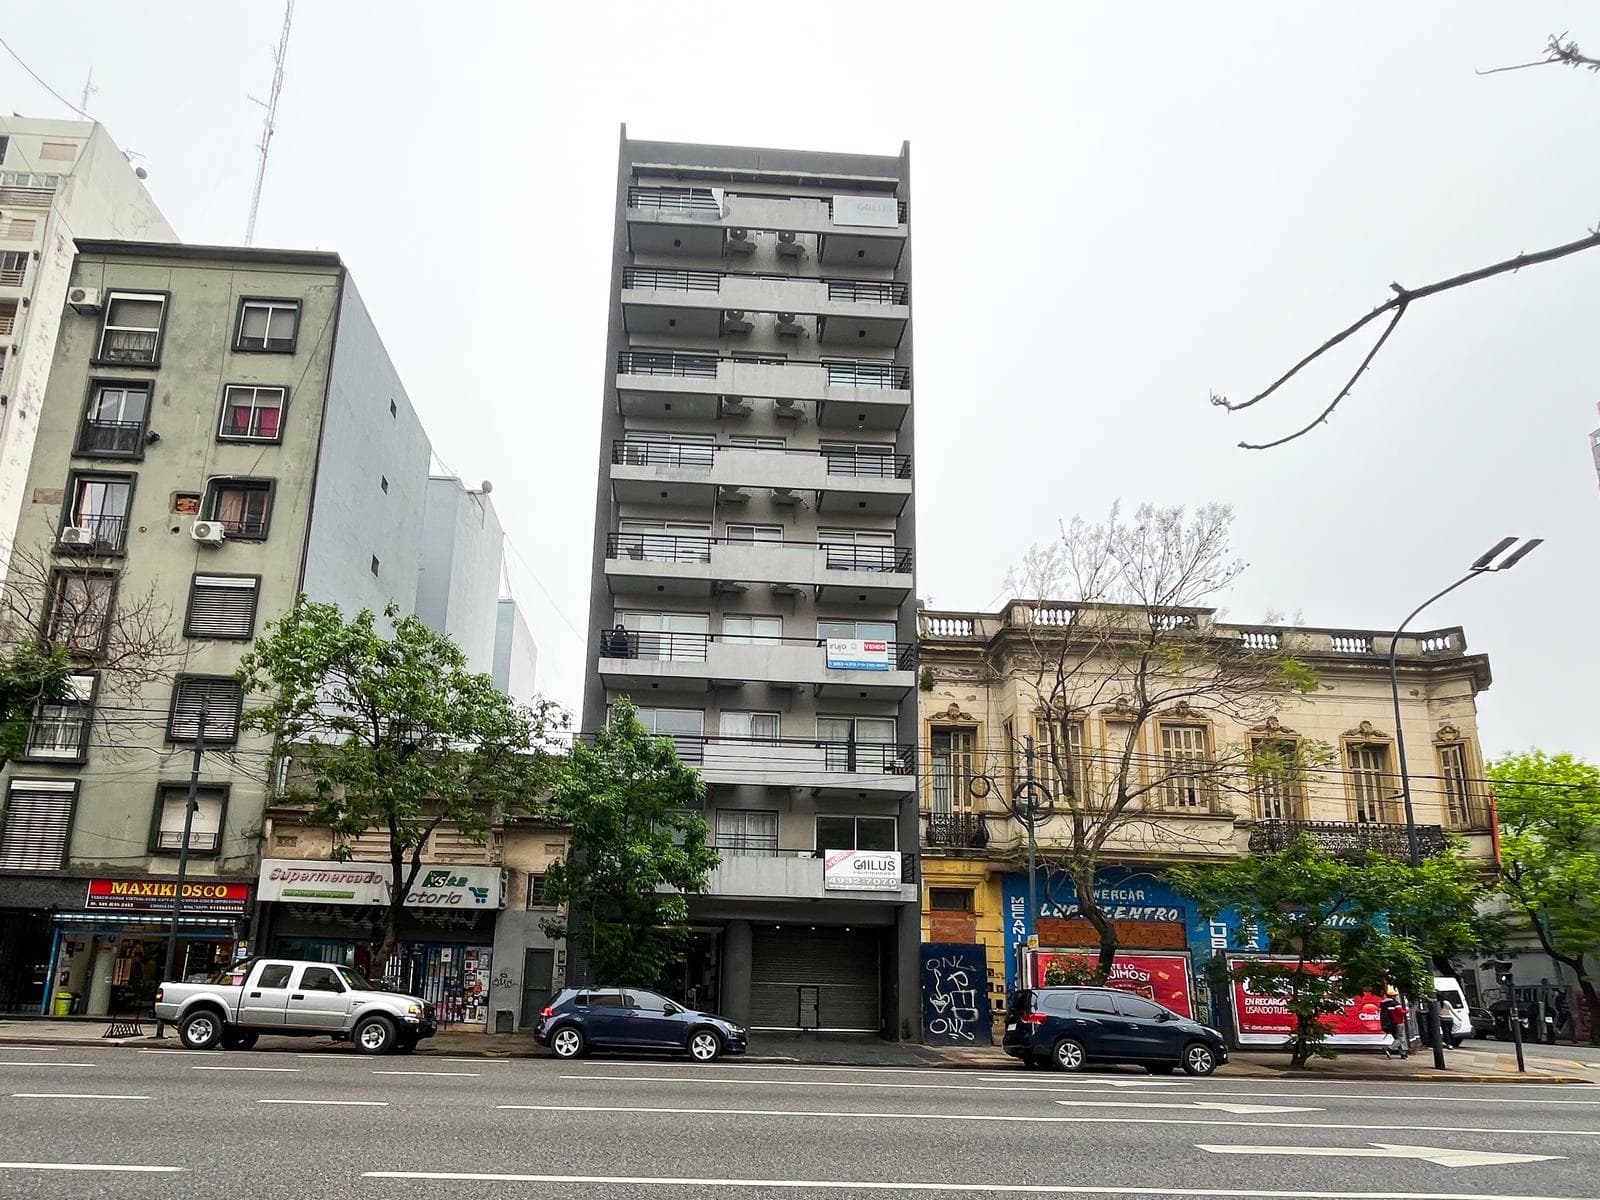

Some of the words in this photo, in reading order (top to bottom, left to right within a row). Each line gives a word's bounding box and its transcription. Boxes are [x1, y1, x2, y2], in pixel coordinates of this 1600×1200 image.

[853, 859, 896, 871] GAILUS
[269, 868, 384, 884] Supermercado
[1072, 888, 1145, 901] TWERCAR
[1107, 970, 1150, 981] JIMOS!
[1244, 998, 1255, 1006] EN
[1255, 998, 1291, 1006] RECARGA
[1245, 1006, 1274, 1014] USANDO
